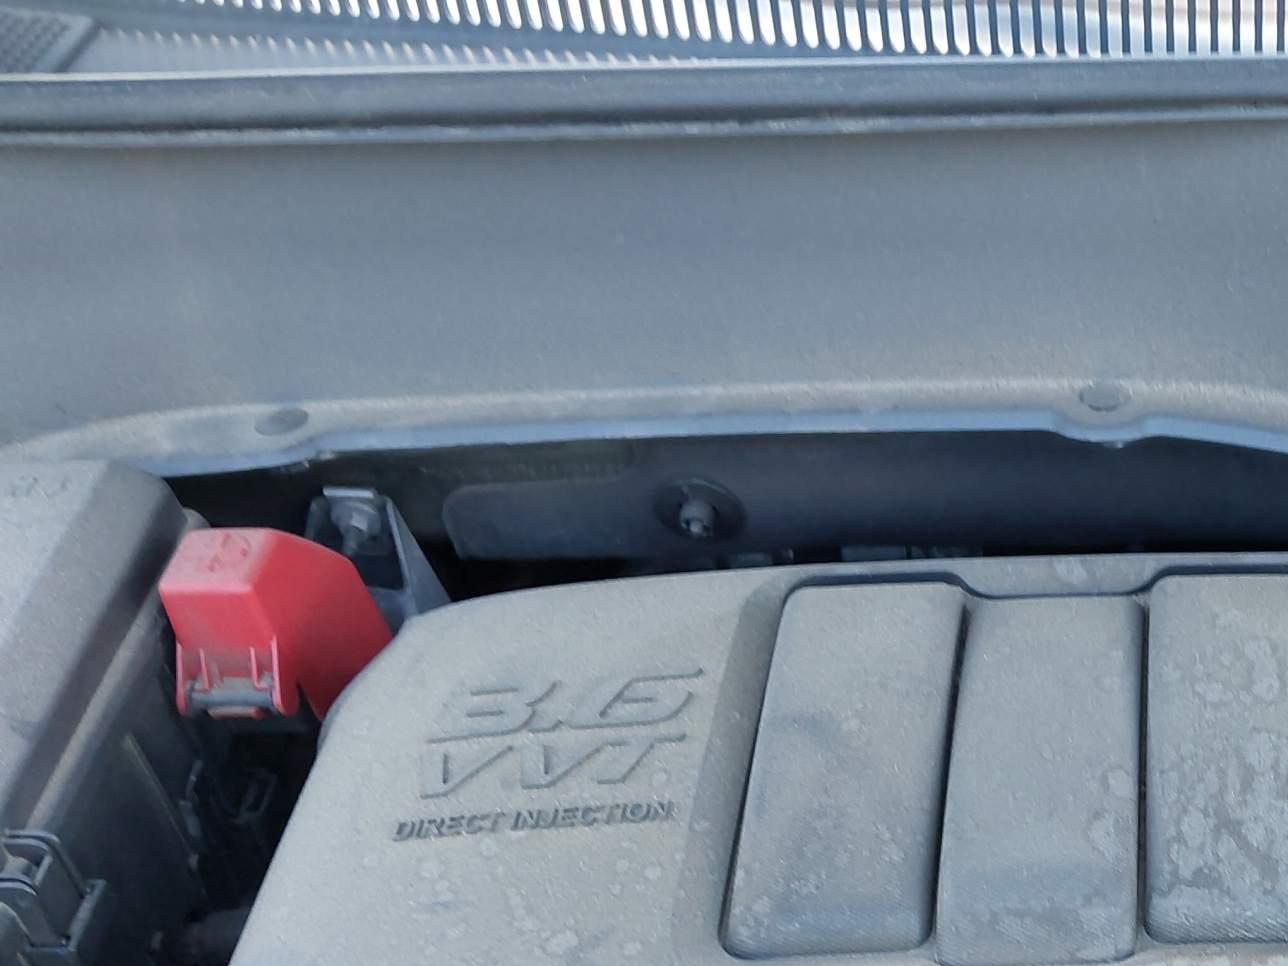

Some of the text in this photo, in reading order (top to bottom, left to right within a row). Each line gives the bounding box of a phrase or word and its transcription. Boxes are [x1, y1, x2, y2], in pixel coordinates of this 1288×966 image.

[427, 667, 705, 744] 3.6
[419, 732, 688, 800] VVT
[392, 799, 677, 842] DIRECT INJECTION
